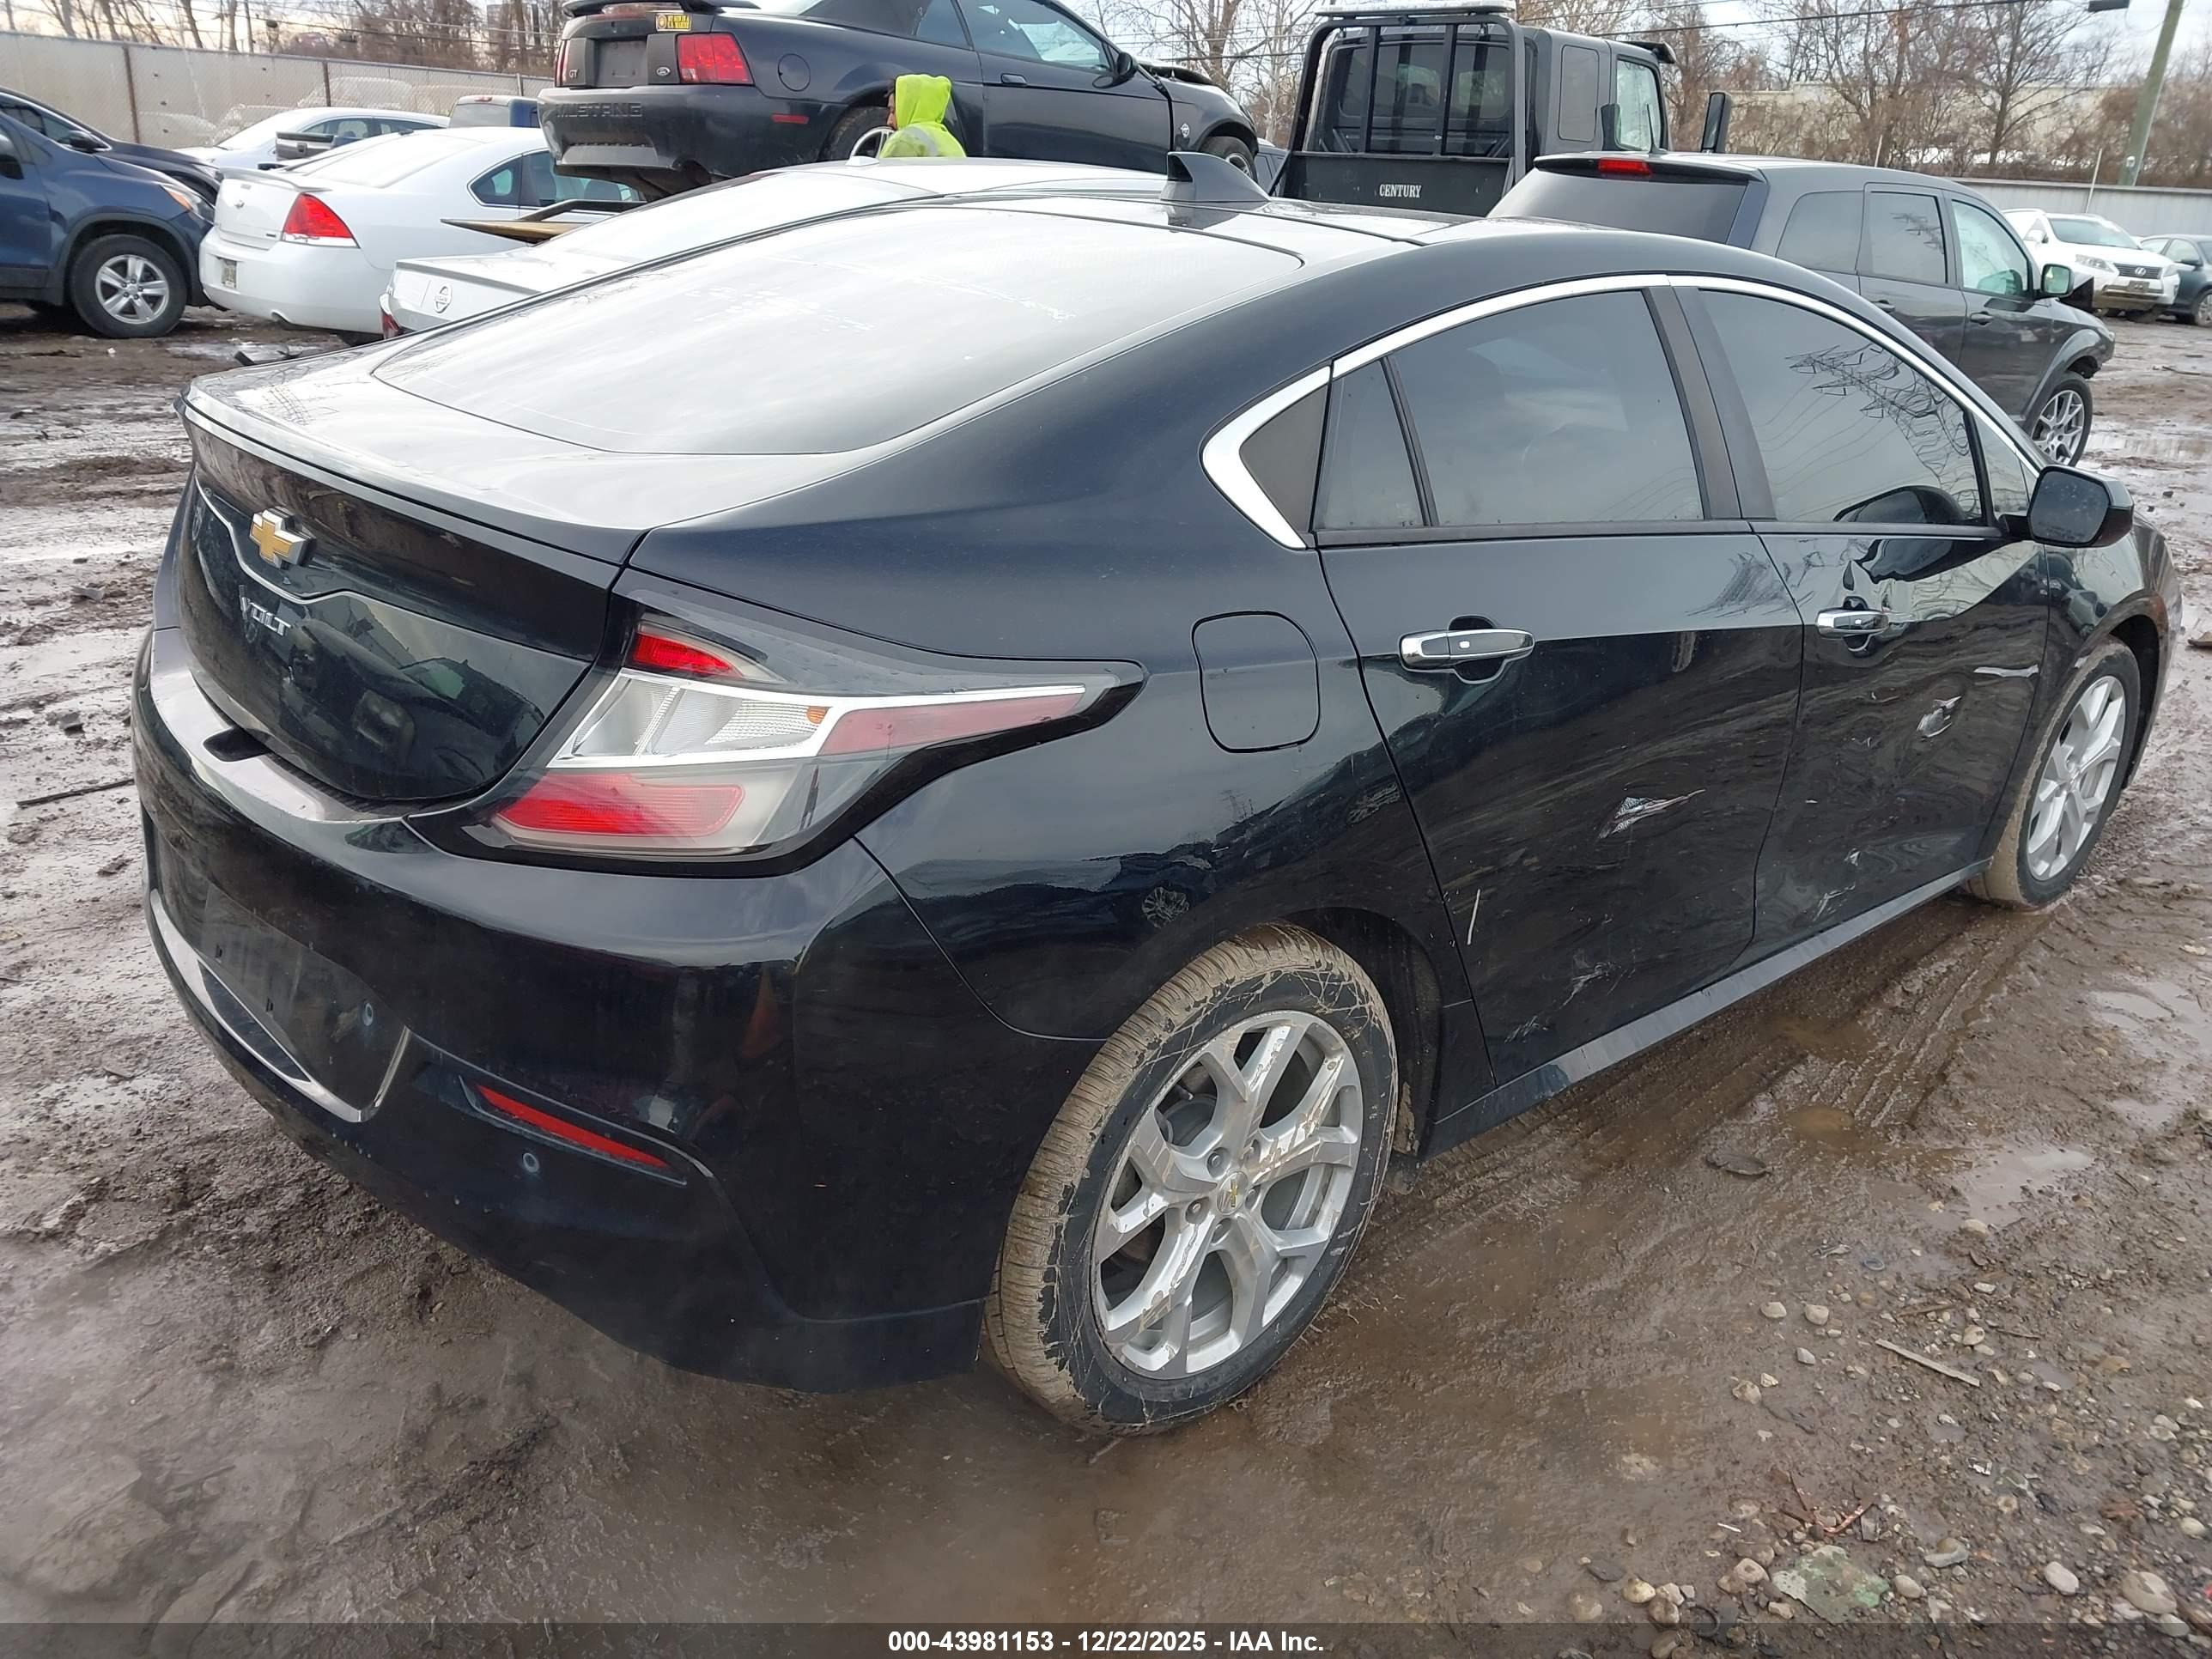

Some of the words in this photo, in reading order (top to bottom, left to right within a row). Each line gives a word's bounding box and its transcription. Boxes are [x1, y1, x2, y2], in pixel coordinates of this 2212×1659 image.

[568, 70, 578, 78] GT
[1379, 184, 1422, 198] CENTURY
[240, 595, 292, 636] VOLT
